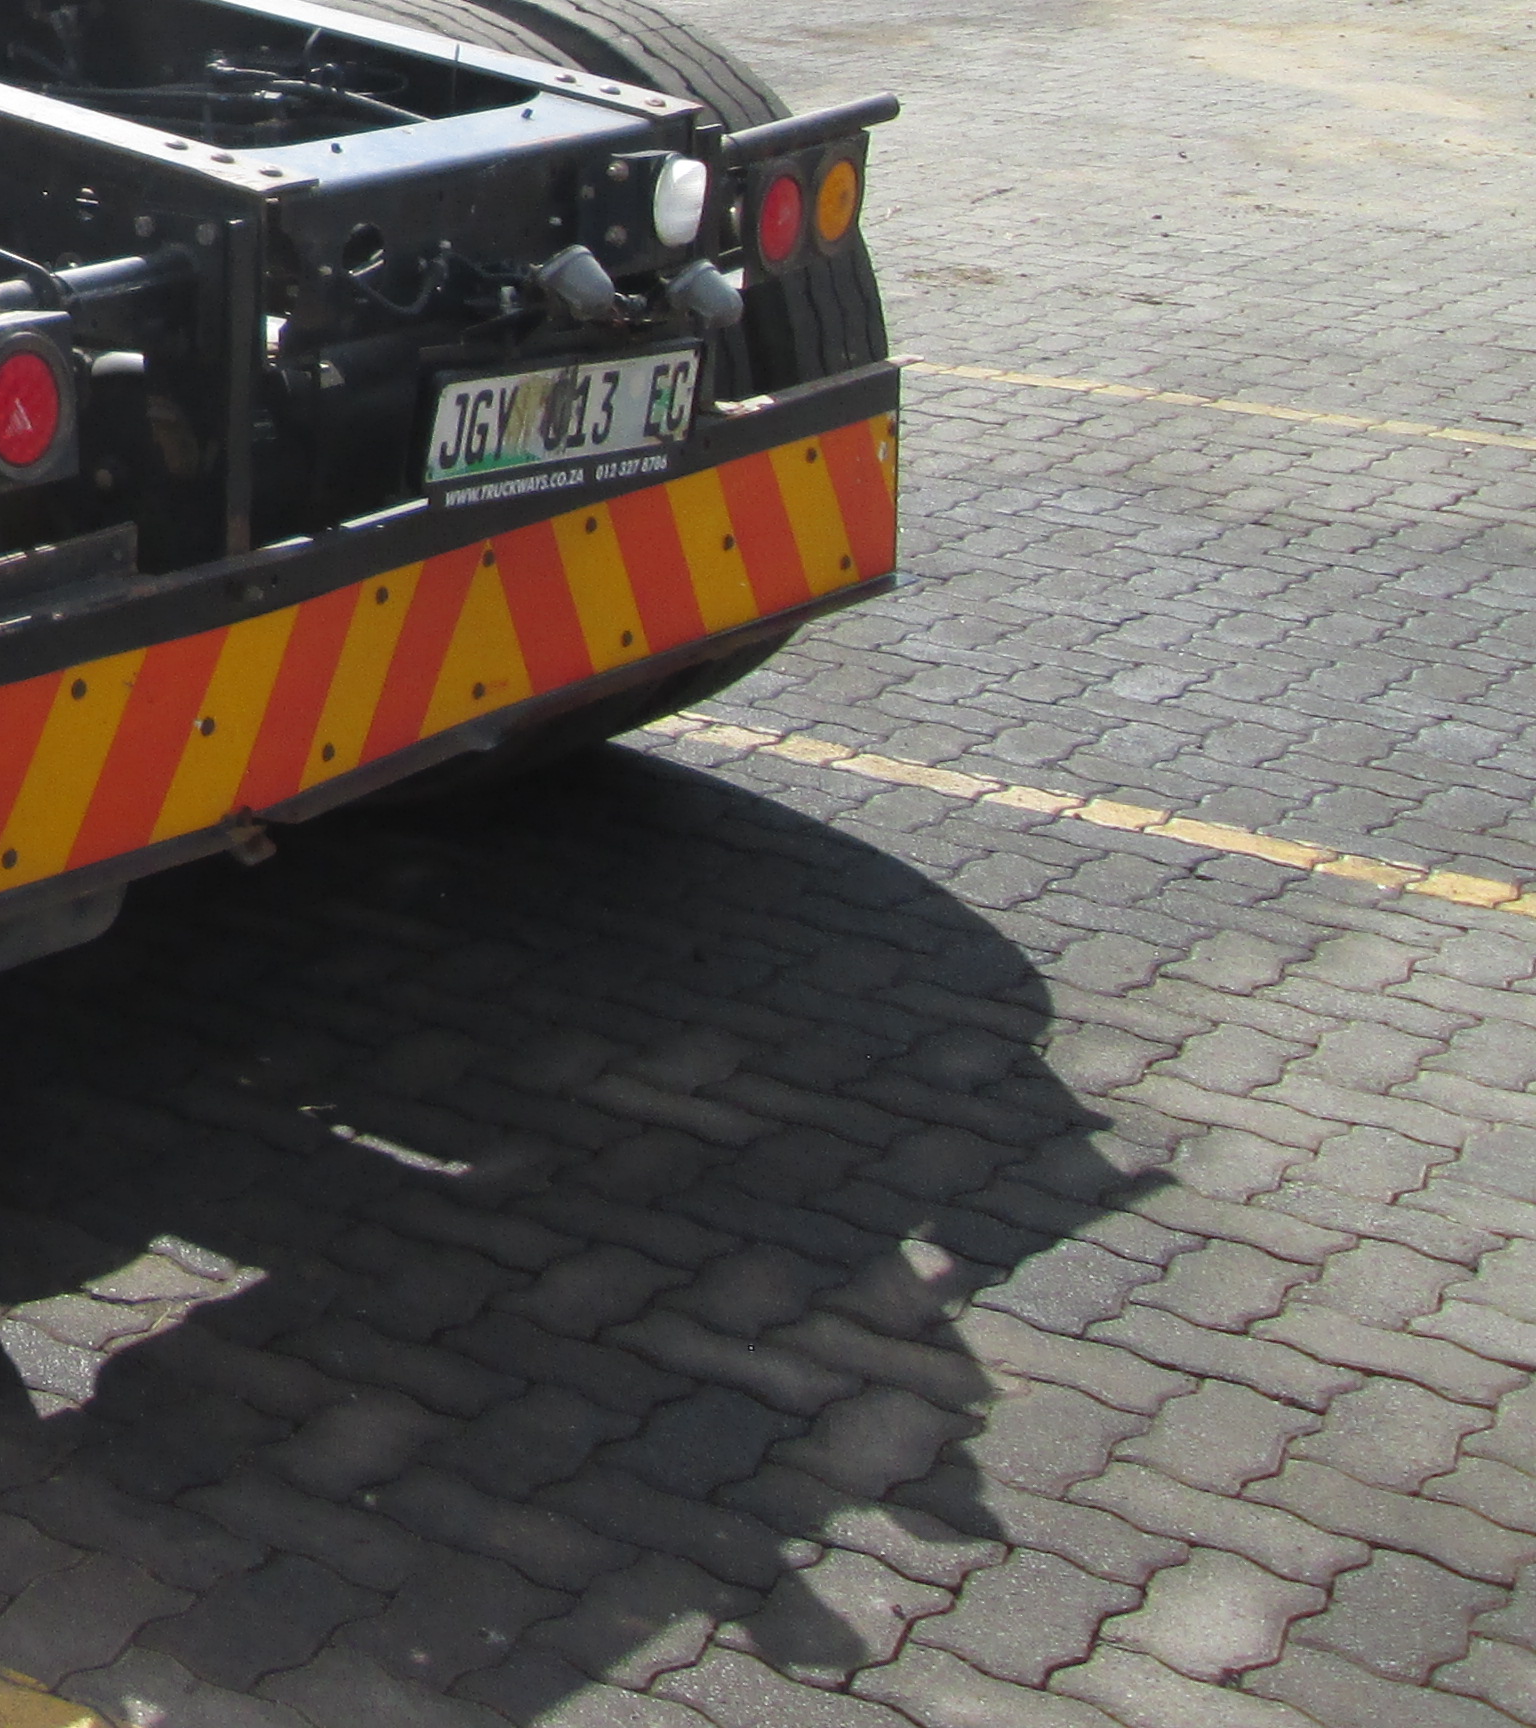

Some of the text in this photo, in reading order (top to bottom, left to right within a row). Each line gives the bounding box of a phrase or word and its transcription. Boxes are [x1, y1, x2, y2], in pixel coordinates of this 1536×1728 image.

[438, 385, 519, 470] JGY
[643, 360, 691, 438] EC
[444, 469, 584, 508] WWW.TRUCKWAYS.CO.ZA
